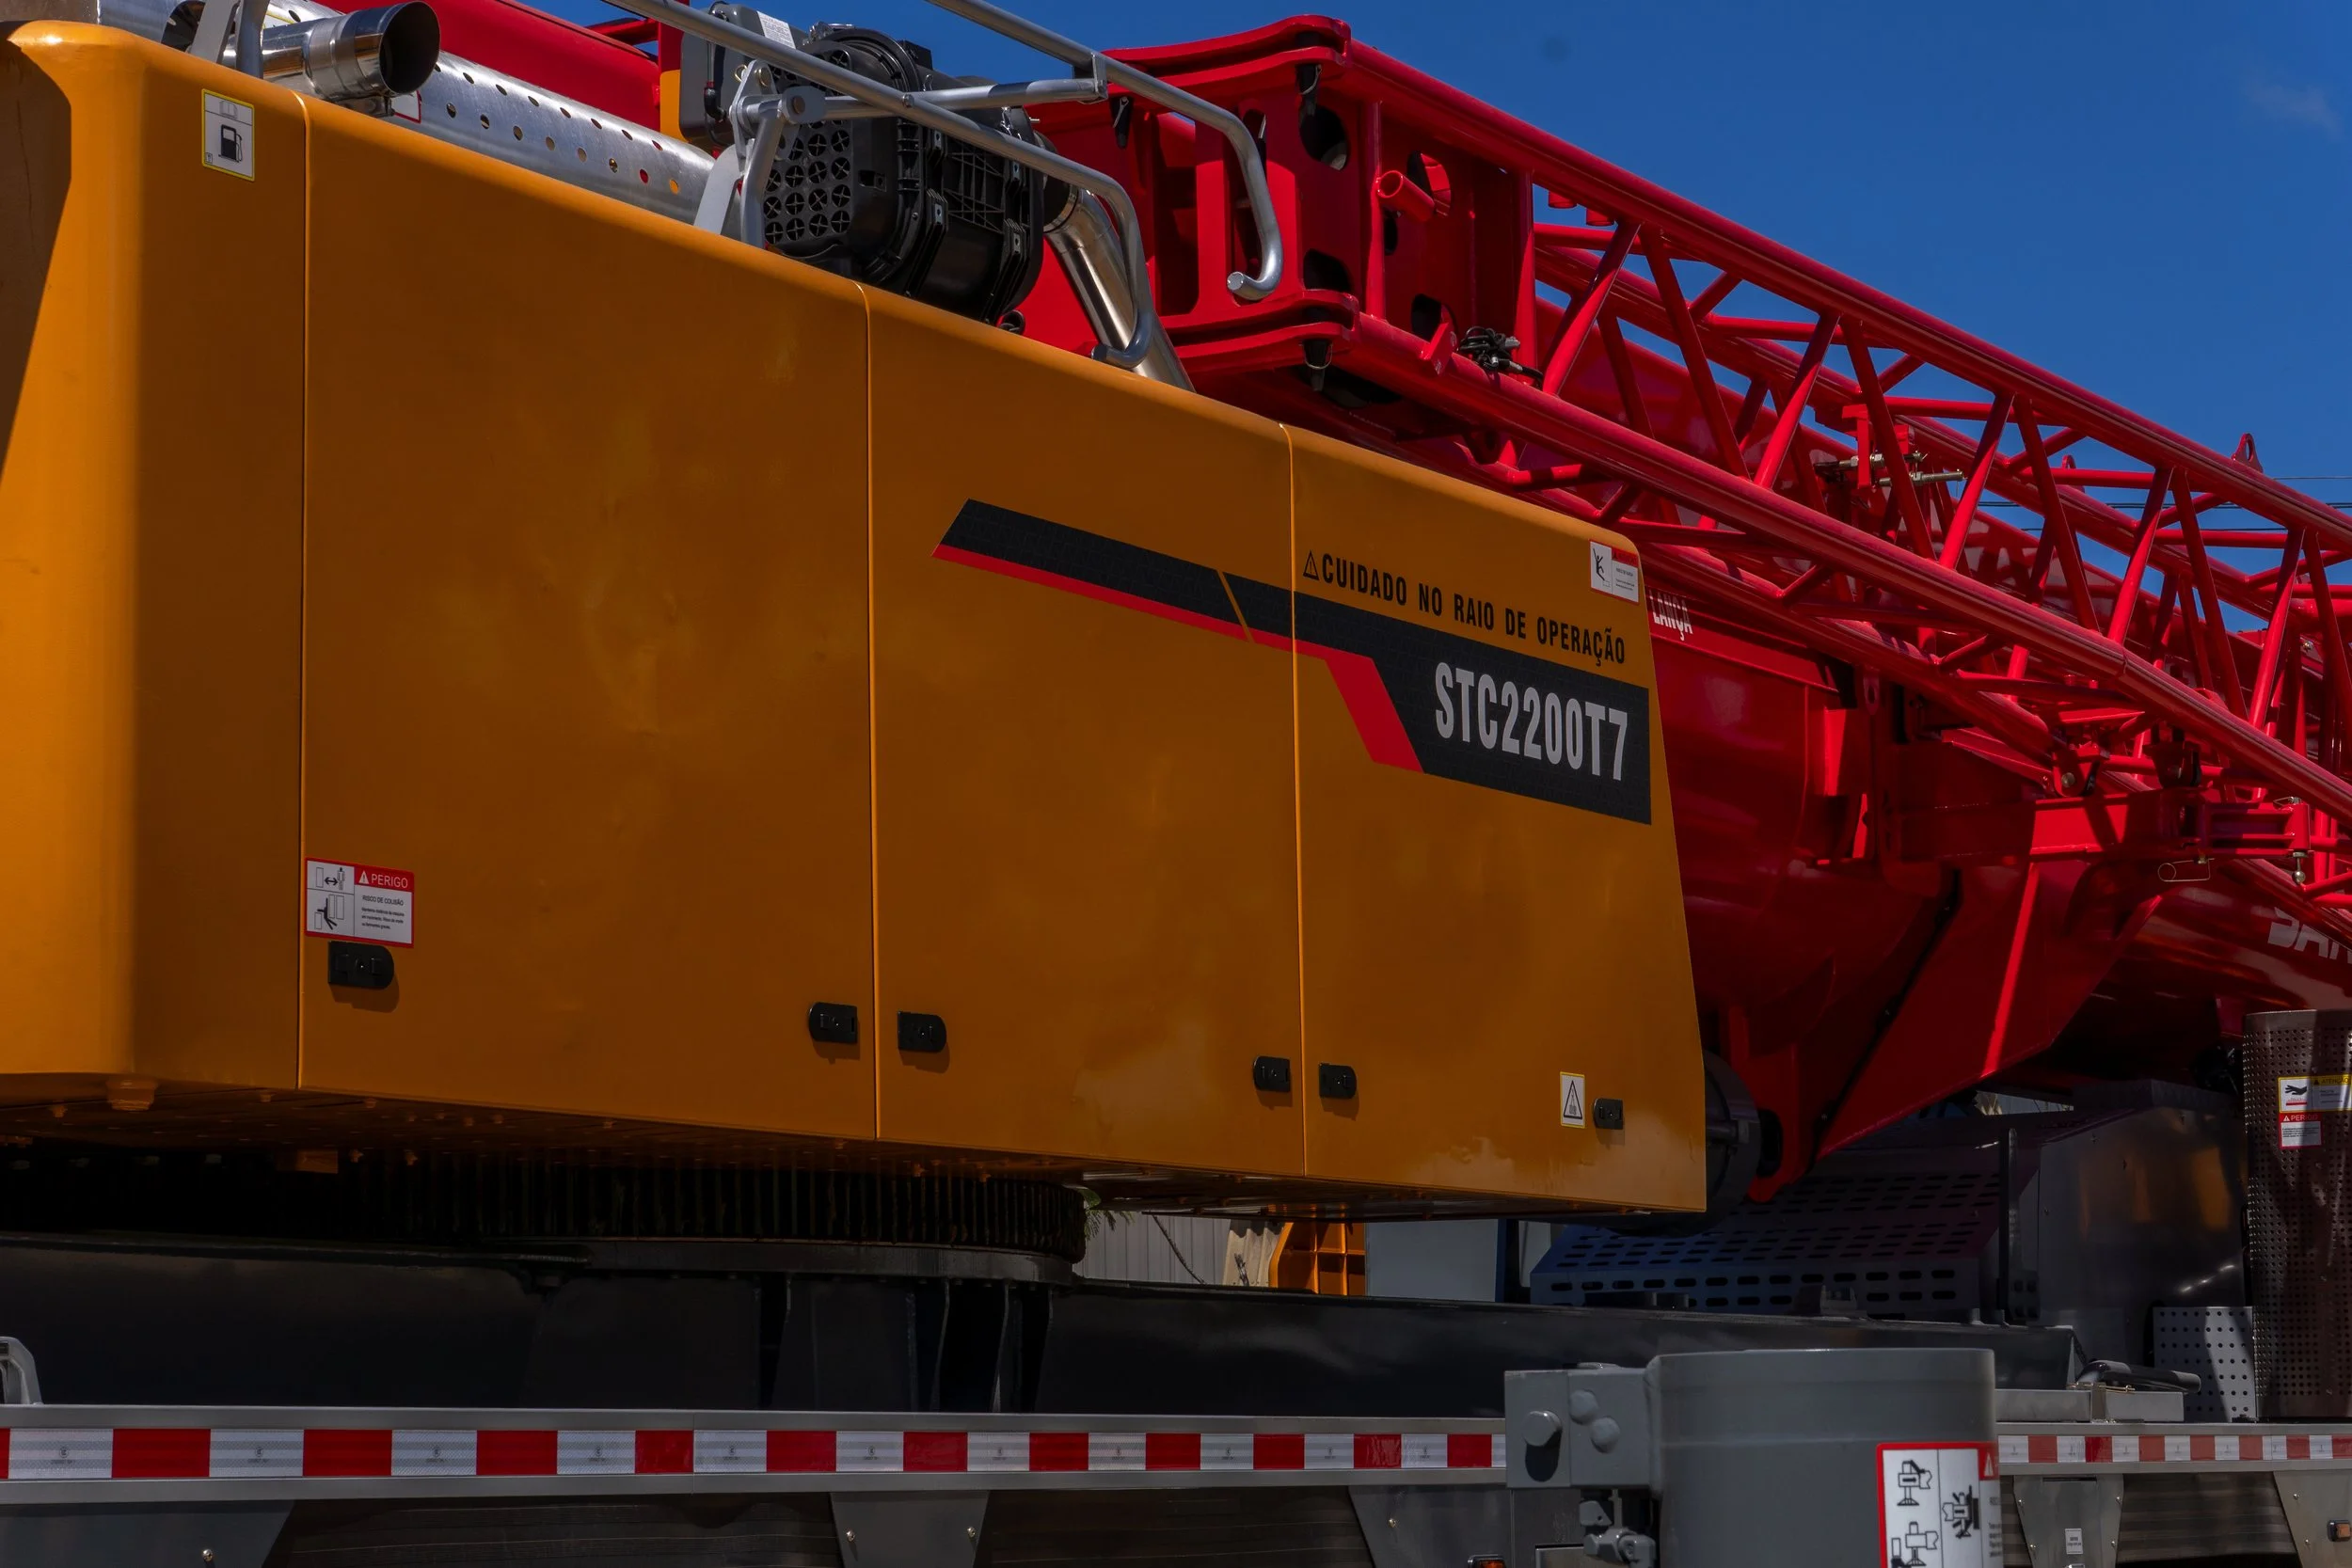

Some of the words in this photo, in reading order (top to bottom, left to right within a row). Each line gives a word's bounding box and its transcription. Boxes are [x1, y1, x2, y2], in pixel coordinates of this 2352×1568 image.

[1322, 553, 1407, 606] CUIDADO
[1418, 583, 1443, 617] NO
[1454, 594, 1494, 630] RAIO
[1505, 609, 1527, 640] DE
[1536, 616, 1626, 667] OPERAÇÃO
[1649, 589, 1693, 641] LANÇA
[1435, 661, 1629, 782] STC2200T7
[371, 873, 408, 889] PERIGO
